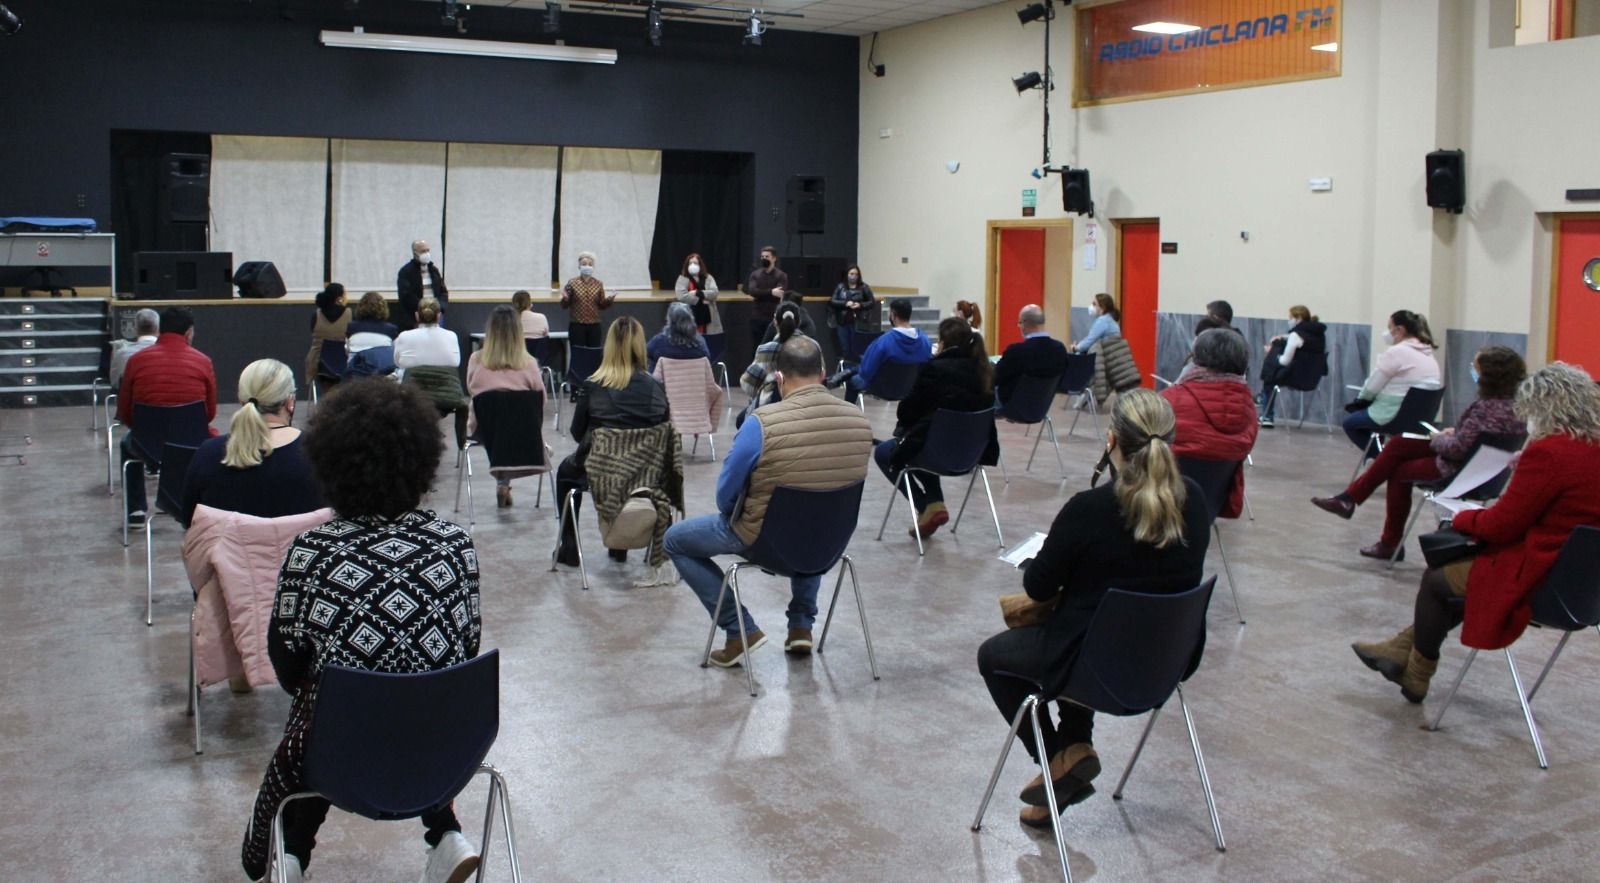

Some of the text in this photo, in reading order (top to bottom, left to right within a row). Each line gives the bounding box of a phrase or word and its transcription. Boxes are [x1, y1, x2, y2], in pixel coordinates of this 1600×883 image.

[1100, 6, 1334, 62] RADIO CHICLANA FM
